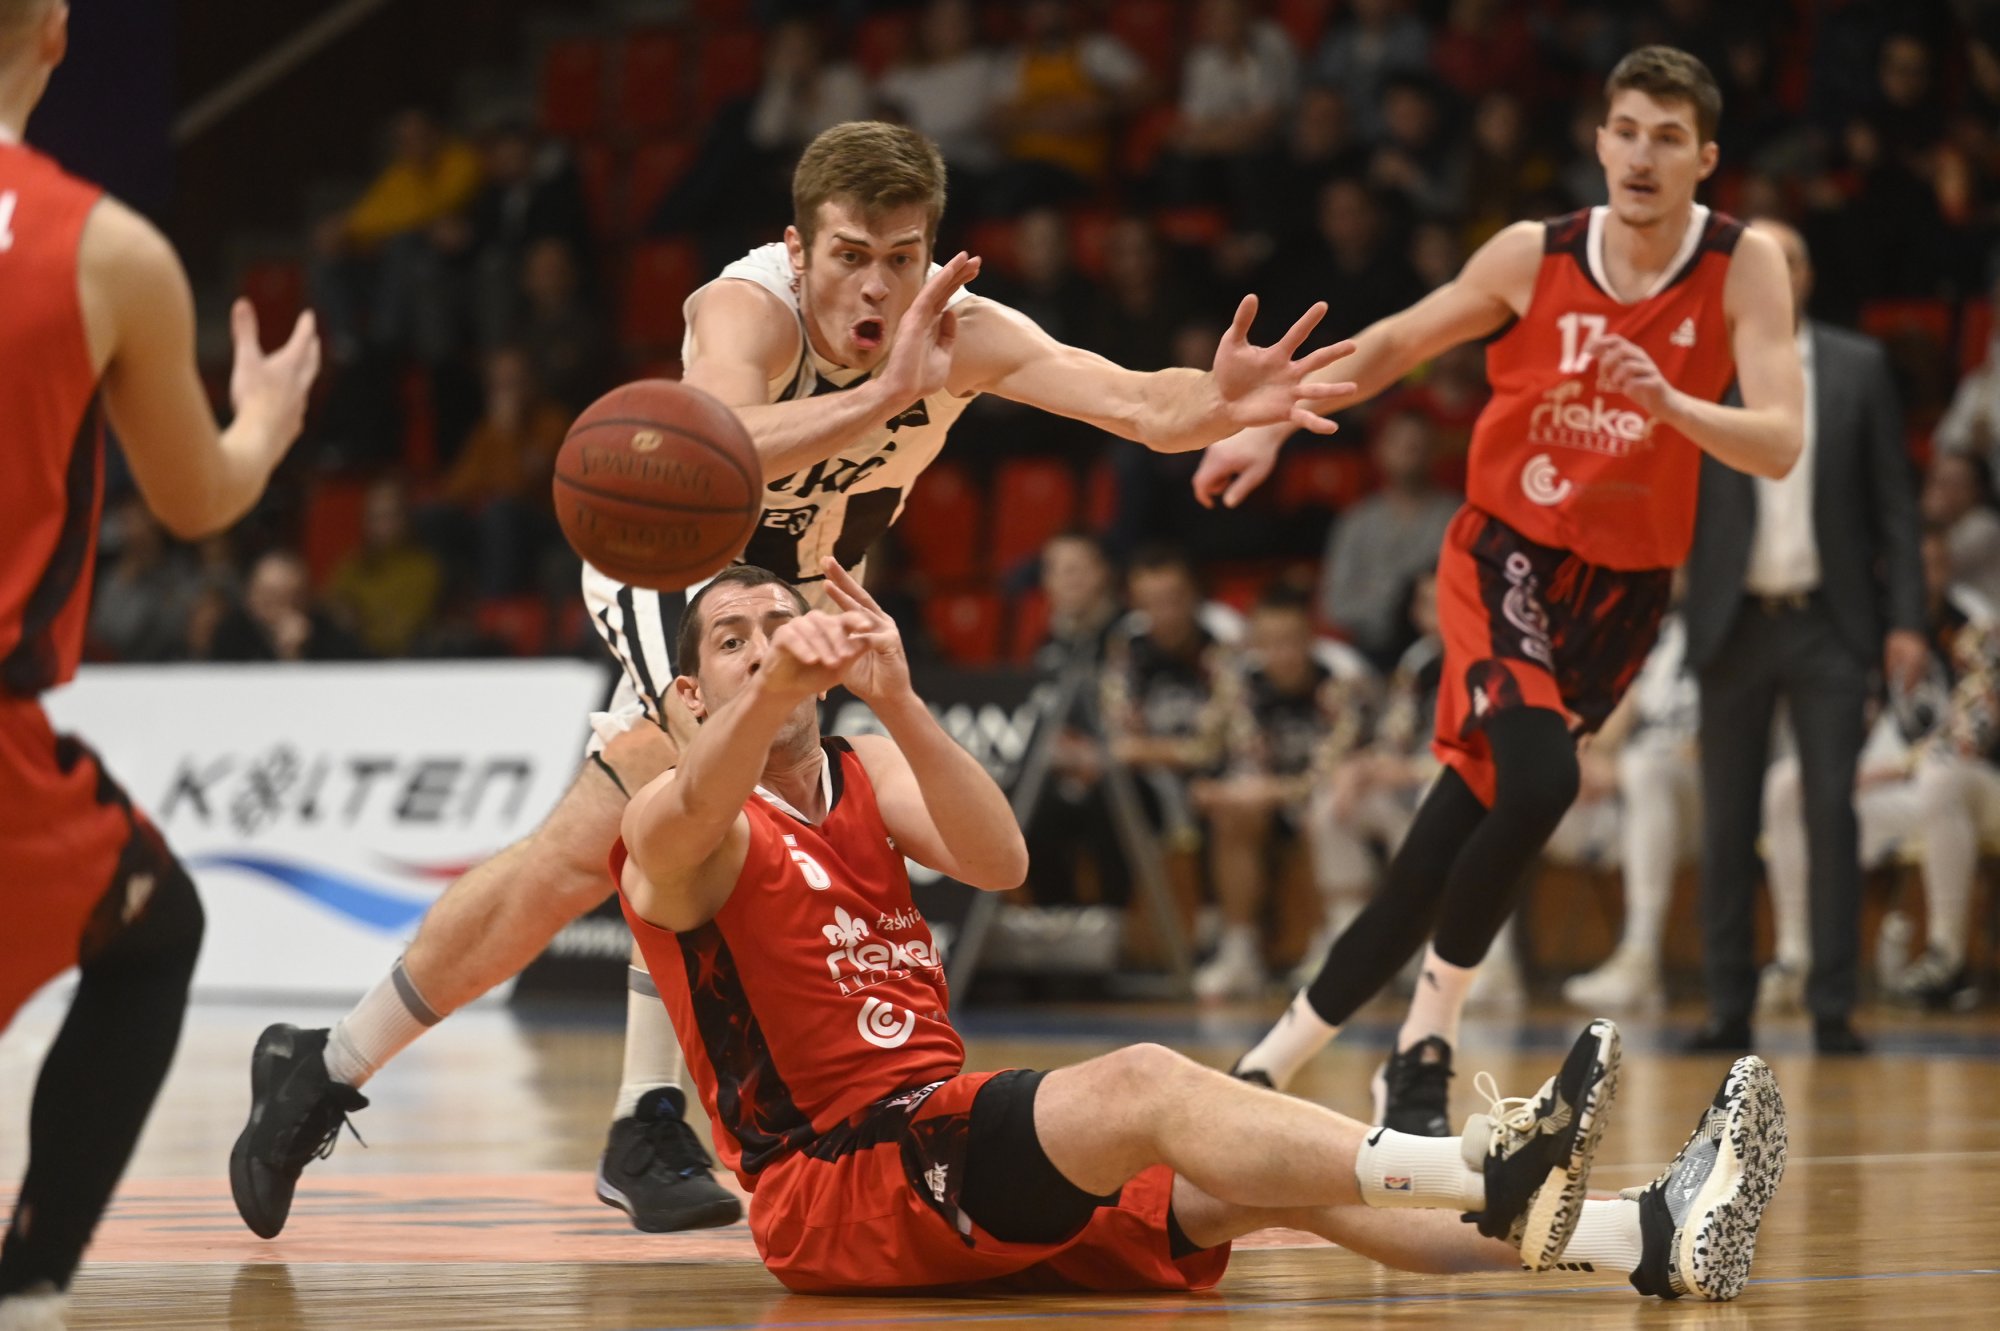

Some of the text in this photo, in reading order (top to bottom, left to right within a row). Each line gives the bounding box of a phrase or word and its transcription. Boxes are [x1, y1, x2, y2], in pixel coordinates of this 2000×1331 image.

[1556, 311, 1609, 373] 17
[876, 907, 922, 931] fashio
[933, 1161, 950, 1204] PEAK
